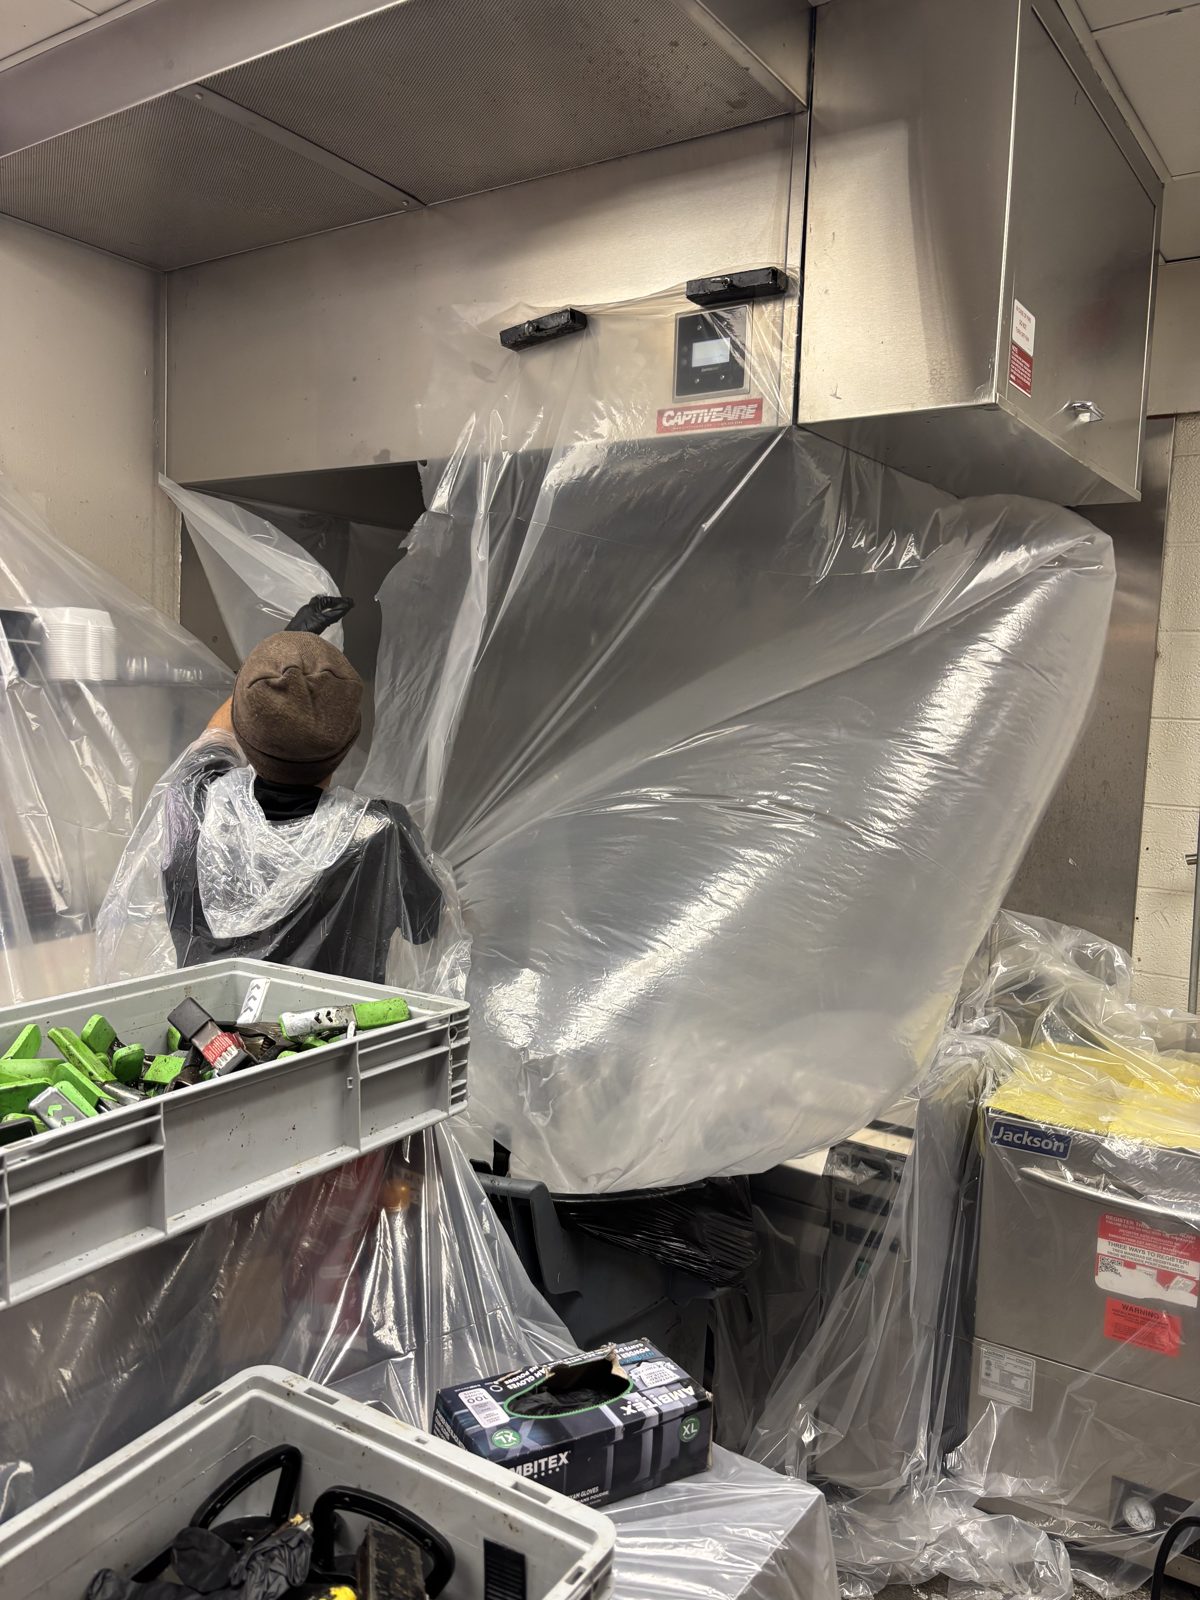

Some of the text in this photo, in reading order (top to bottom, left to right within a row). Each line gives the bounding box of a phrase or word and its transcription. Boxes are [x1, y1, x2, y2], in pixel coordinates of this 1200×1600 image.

[994, 1127, 1064, 1152] Jackson
[1107, 1241, 1127, 1250] THREE
[1127, 1246, 1145, 1254] WAYS
[507, 1375, 535, 1389] GLOVES
[467, 1395, 489, 1404] 100
[620, 1386, 695, 1415] AMBITEX
[683, 1423, 698, 1436] XL
[494, 1433, 517, 1443] XL
[508, 1451, 569, 1477] MBITEX
